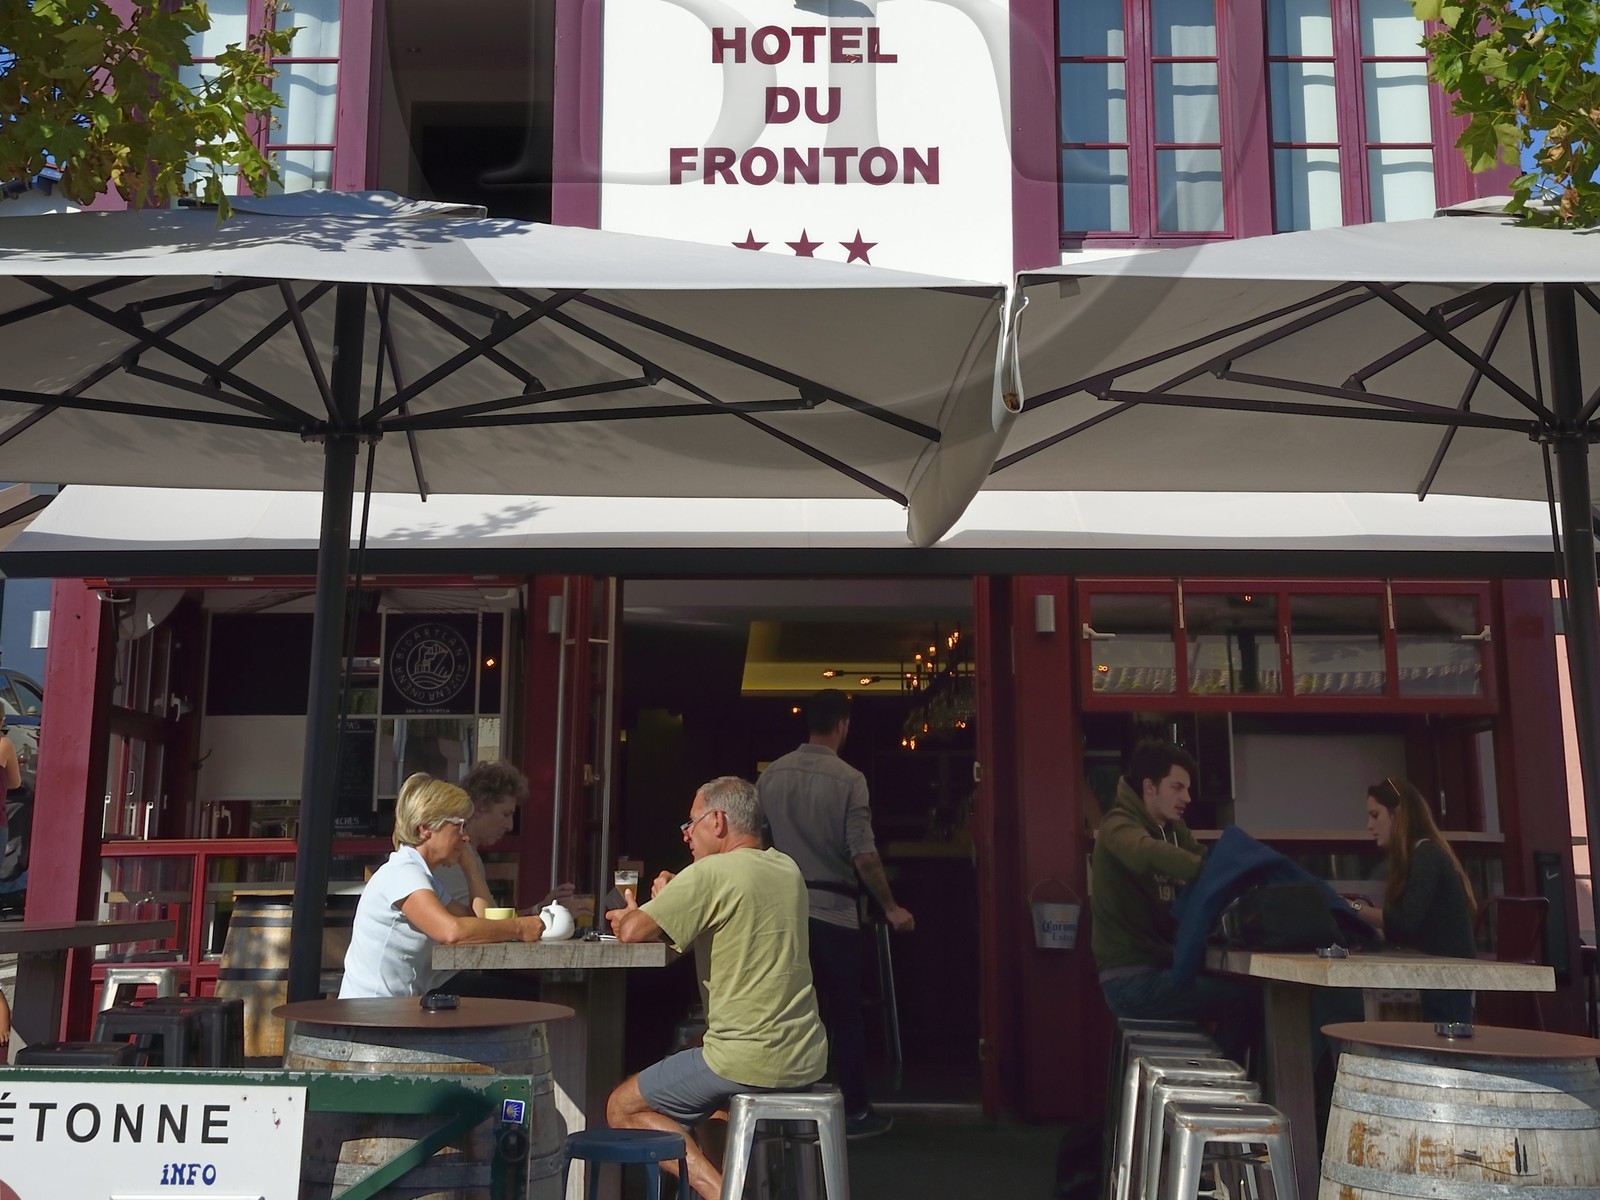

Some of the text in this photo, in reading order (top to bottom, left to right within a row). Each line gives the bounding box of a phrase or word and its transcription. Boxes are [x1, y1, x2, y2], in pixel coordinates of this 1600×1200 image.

[711, 25, 898, 65] HOTEL
[765, 86, 842, 124] DU
[669, 146, 940, 185] FRONTON
[0, 1092, 231, 1144] ÉTONNE
